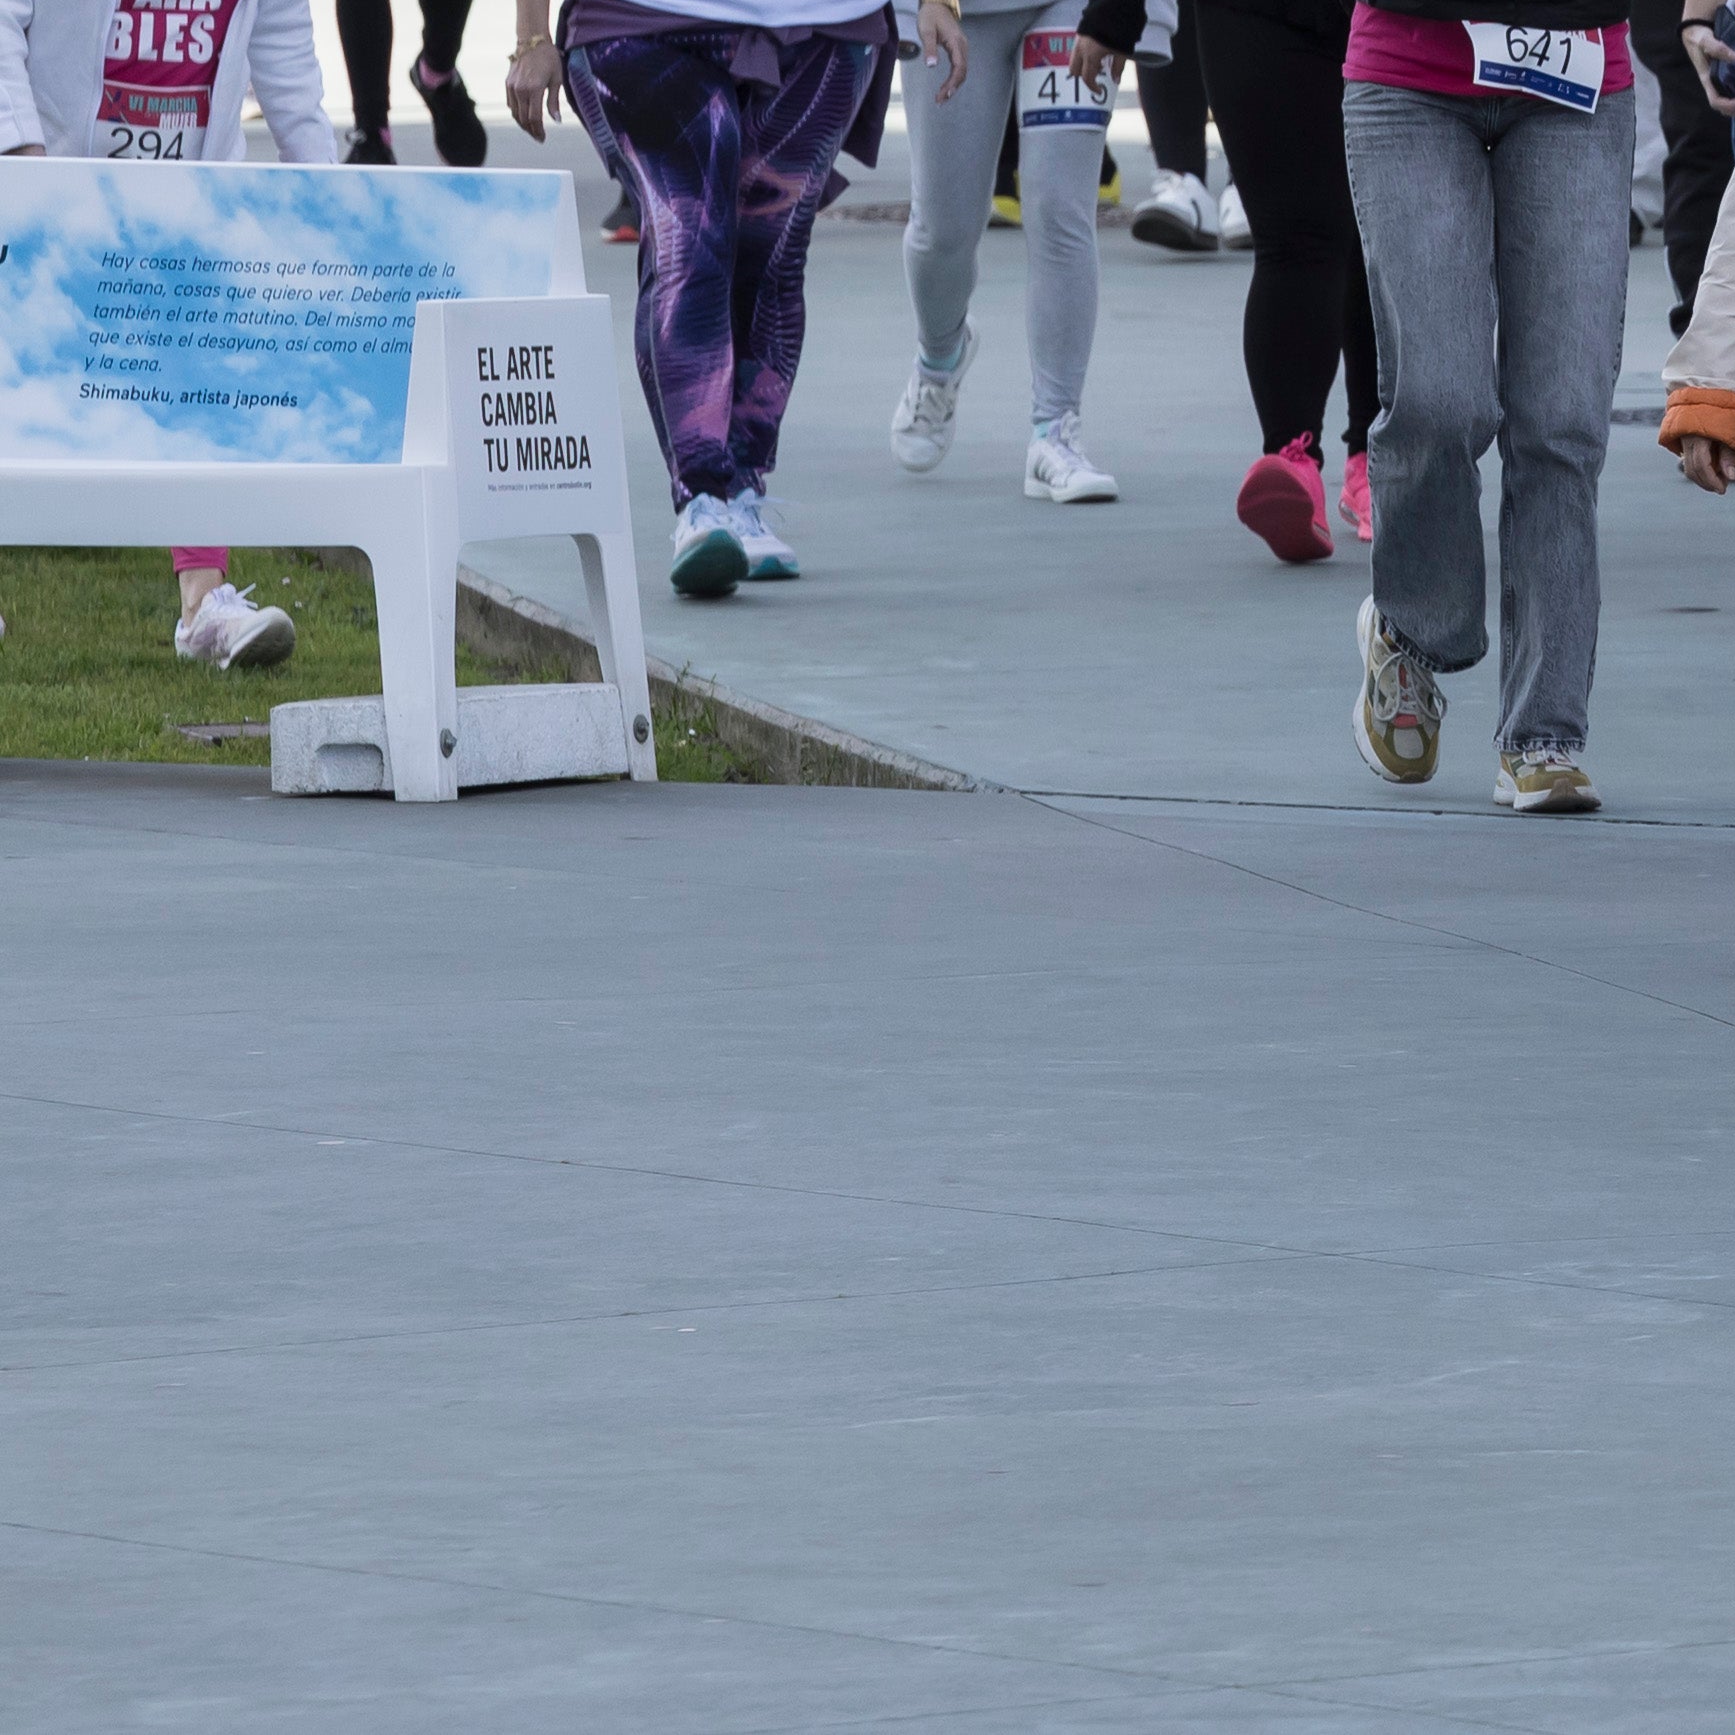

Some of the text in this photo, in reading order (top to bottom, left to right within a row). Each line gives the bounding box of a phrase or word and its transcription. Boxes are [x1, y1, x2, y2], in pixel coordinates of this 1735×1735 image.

[104, 12, 215, 64] BLES
[1506, 26, 1572, 75] 641
[129, 95, 198, 112] VI MARCHA
[159, 113, 198, 129] MUJER
[108, 128, 184, 160] 294
[101, 252, 455, 280] Hay cosas hermosas que forman parte de la
[97, 279, 166, 298] mañana,
[174, 284, 220, 298] cosas
[226, 285, 257, 302] que
[262, 284, 312, 303] quiero
[319, 289, 344, 302] ver.
[351, 286, 411, 303] Debería
[93, 304, 161, 322] también
[166, 306, 180, 322] el
[185, 308, 218, 323] arte
[222, 310, 298, 326] matutino.
[304, 310, 331, 327] Del
[336, 313, 388, 328] mismo
[89, 331, 120, 347] que
[125, 331, 173, 347] existe
[178, 333, 194, 348] el
[198, 333, 279, 353] desayuno,
[285, 336, 311, 351] así
[313, 339, 357, 353] como
[363, 338, 378, 353] el
[84, 354, 162, 372] y la cena.
[478, 346, 555, 381] EL ARTE
[79, 383, 297, 409] Shimabuku, artista japonés
[481, 391, 557, 427] CAMBIA
[483, 435, 592, 473] TU MIRADA
